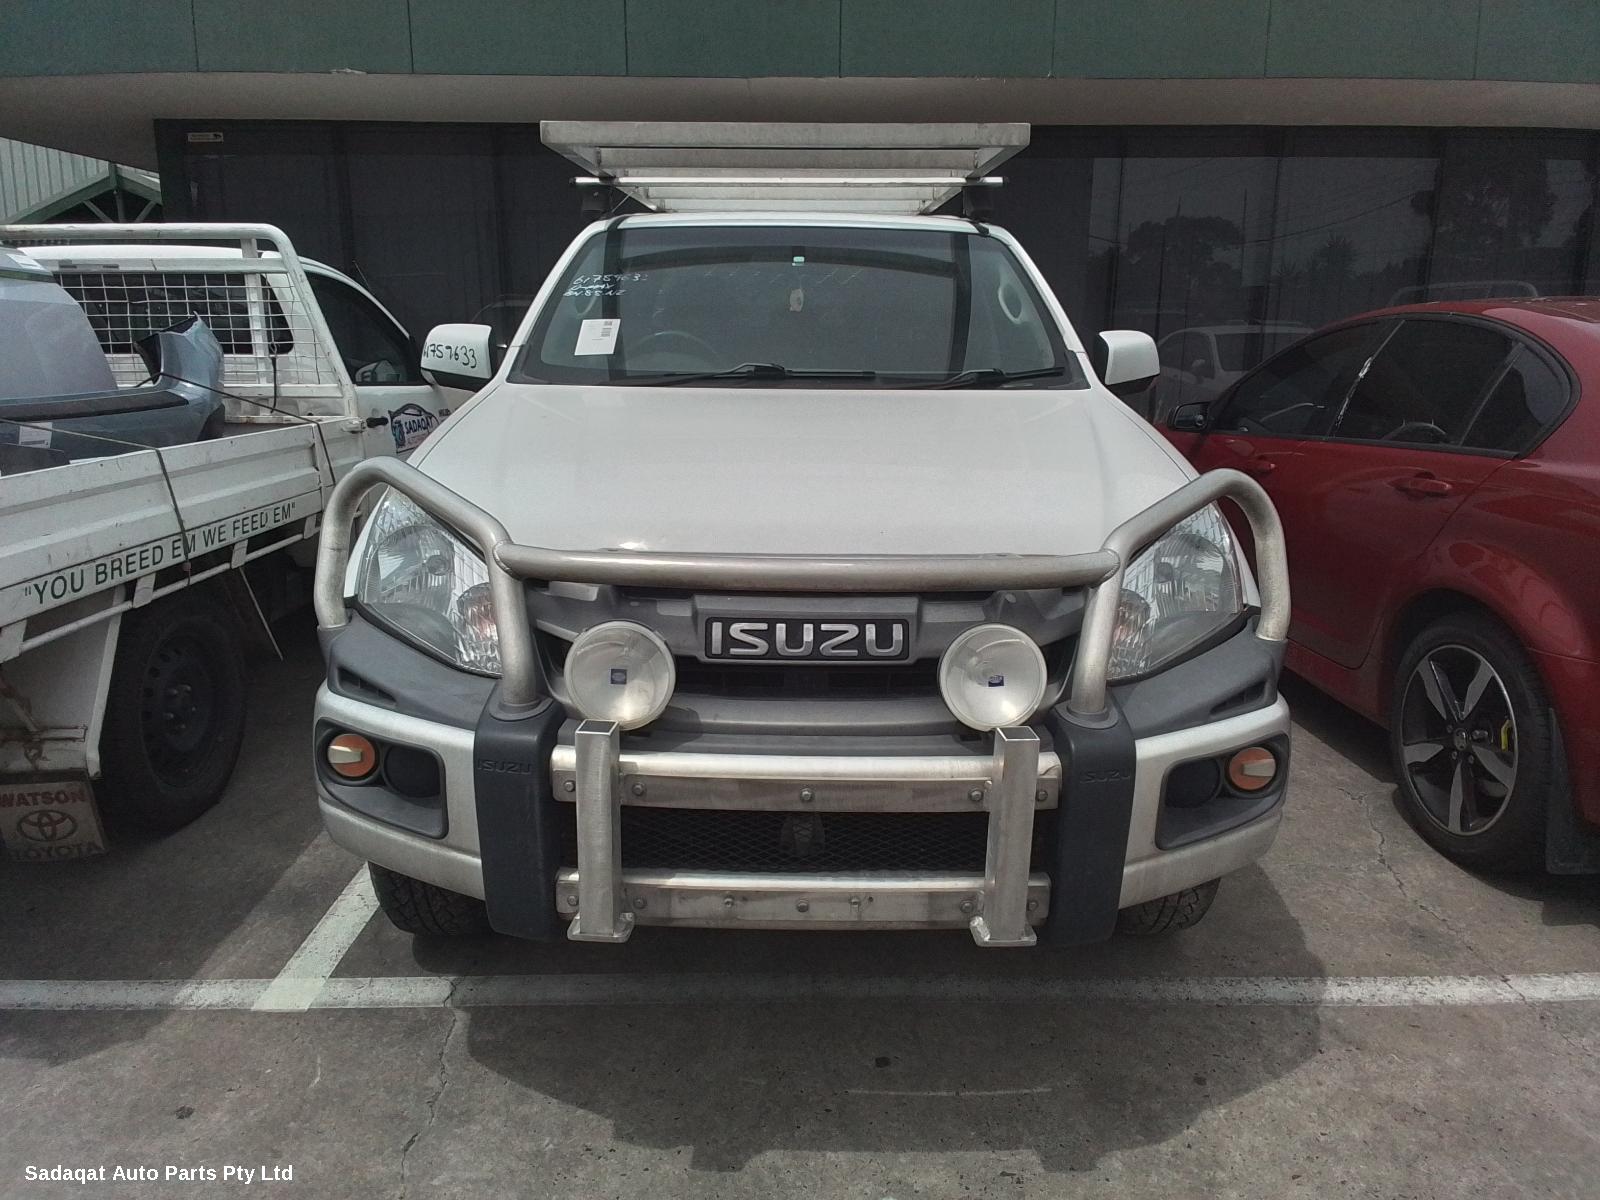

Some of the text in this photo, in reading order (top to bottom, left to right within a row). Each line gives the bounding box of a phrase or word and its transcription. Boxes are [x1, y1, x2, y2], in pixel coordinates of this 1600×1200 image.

[94, 545, 165, 586] BREED
[171, 533, 197, 558] EM
[203, 526, 227, 547] WE
[231, 510, 269, 538] FEED
[711, 621, 904, 657] ISUZU
[0, 790, 86, 808] WATSON
